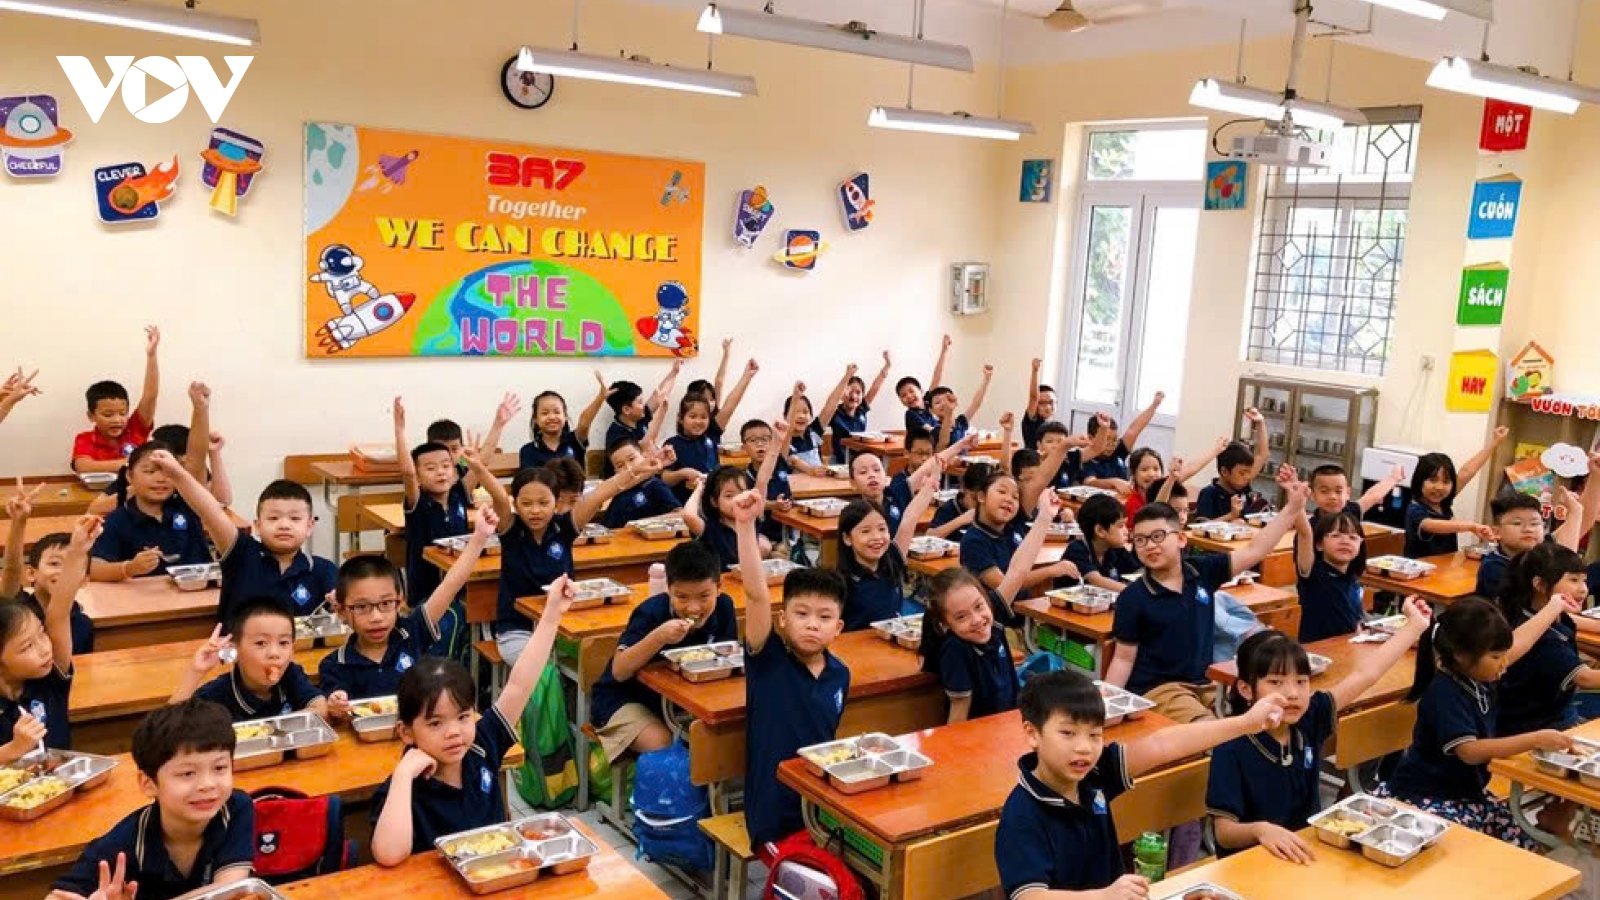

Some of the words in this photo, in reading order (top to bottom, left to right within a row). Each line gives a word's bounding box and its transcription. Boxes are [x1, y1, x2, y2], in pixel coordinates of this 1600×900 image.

[1494, 110, 1524, 136] MỘT
[97, 166, 142, 182] CLEVER
[486, 151, 586, 191] 3A7
[487, 194, 587, 221] Together
[1478, 193, 1515, 220] CUỐN
[376, 215, 445, 251] WE
[454, 220, 532, 255] CAN
[541, 227, 679, 263] CHANGE
[484, 272, 570, 311] THE
[1467, 283, 1503, 307] SÁCH
[459, 316, 604, 355] WORLD
[1461, 377, 1486, 394] HAY
